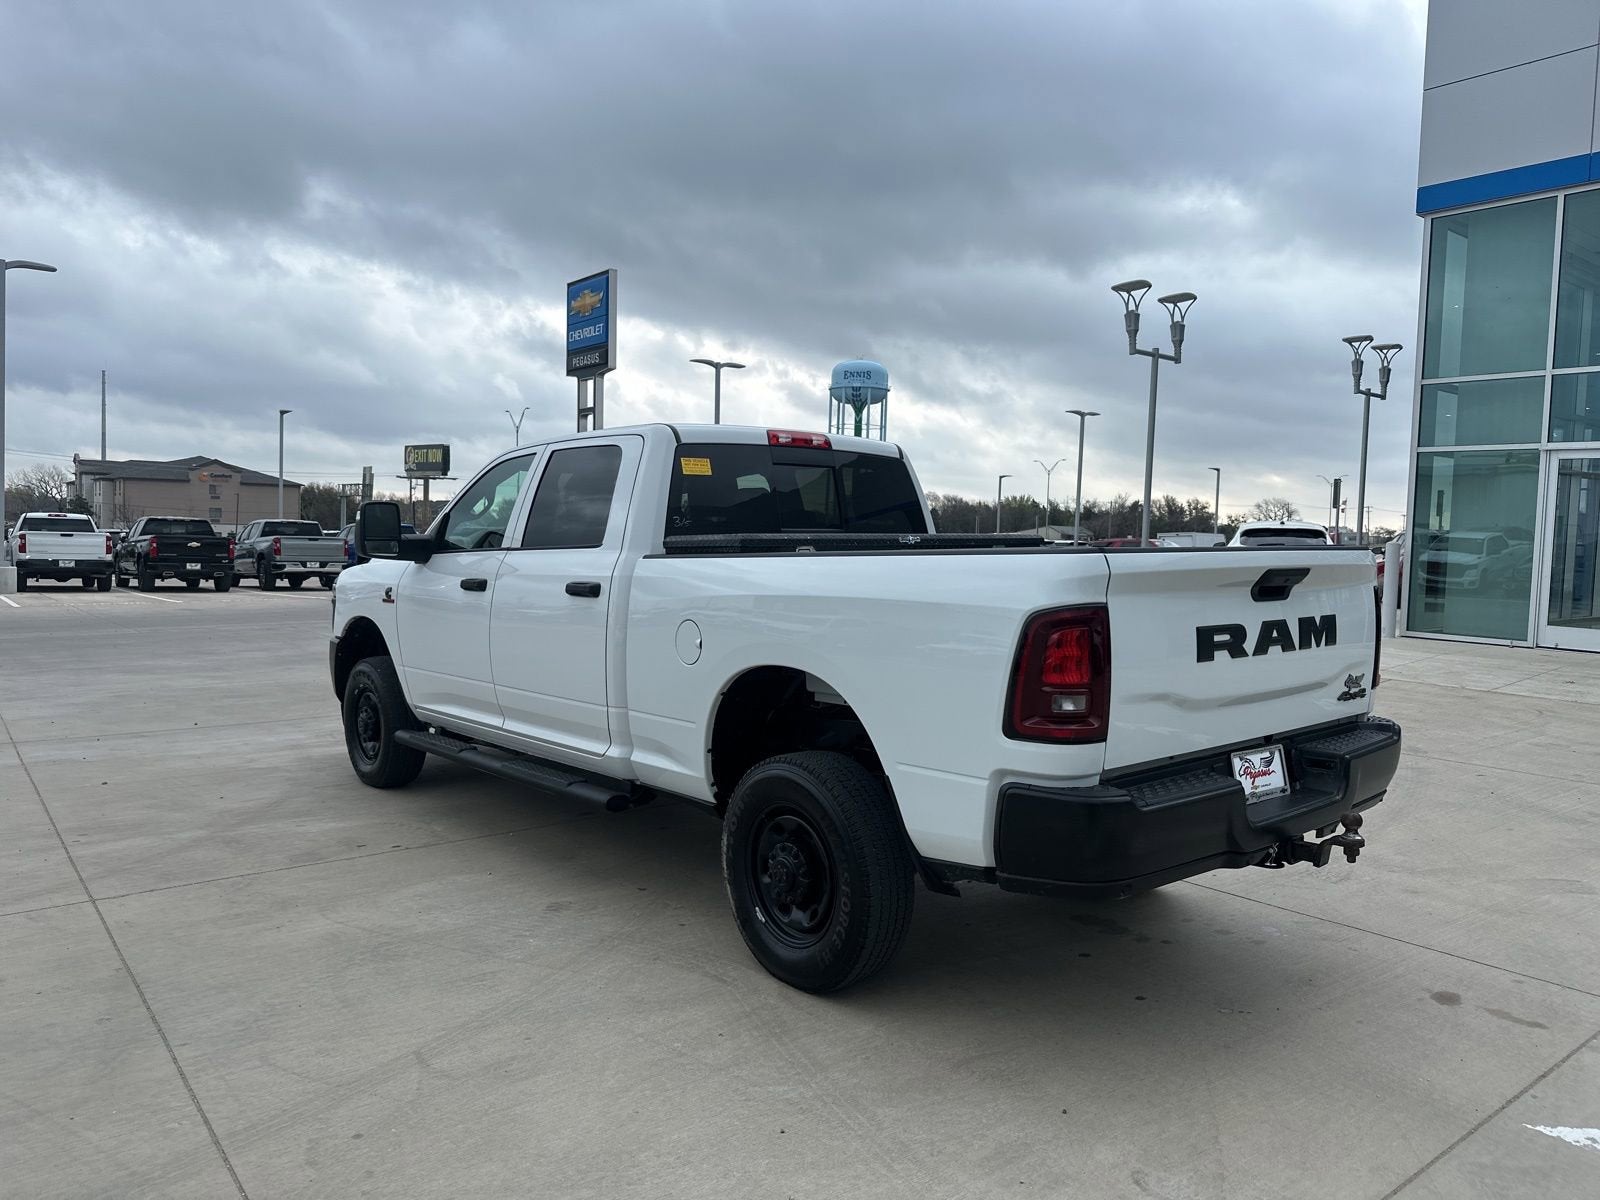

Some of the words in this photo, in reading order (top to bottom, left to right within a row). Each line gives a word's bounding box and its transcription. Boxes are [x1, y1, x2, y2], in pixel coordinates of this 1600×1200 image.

[569, 323, 604, 342] CHEVROLET
[572, 352, 600, 367] PEGASUS
[843, 370, 872, 380] ENNIS
[414, 449, 428, 463] EXIT
[428, 448, 443, 463] NOW
[1196, 614, 1337, 663] RAM
[1243, 766, 1277, 786] Pegasus
